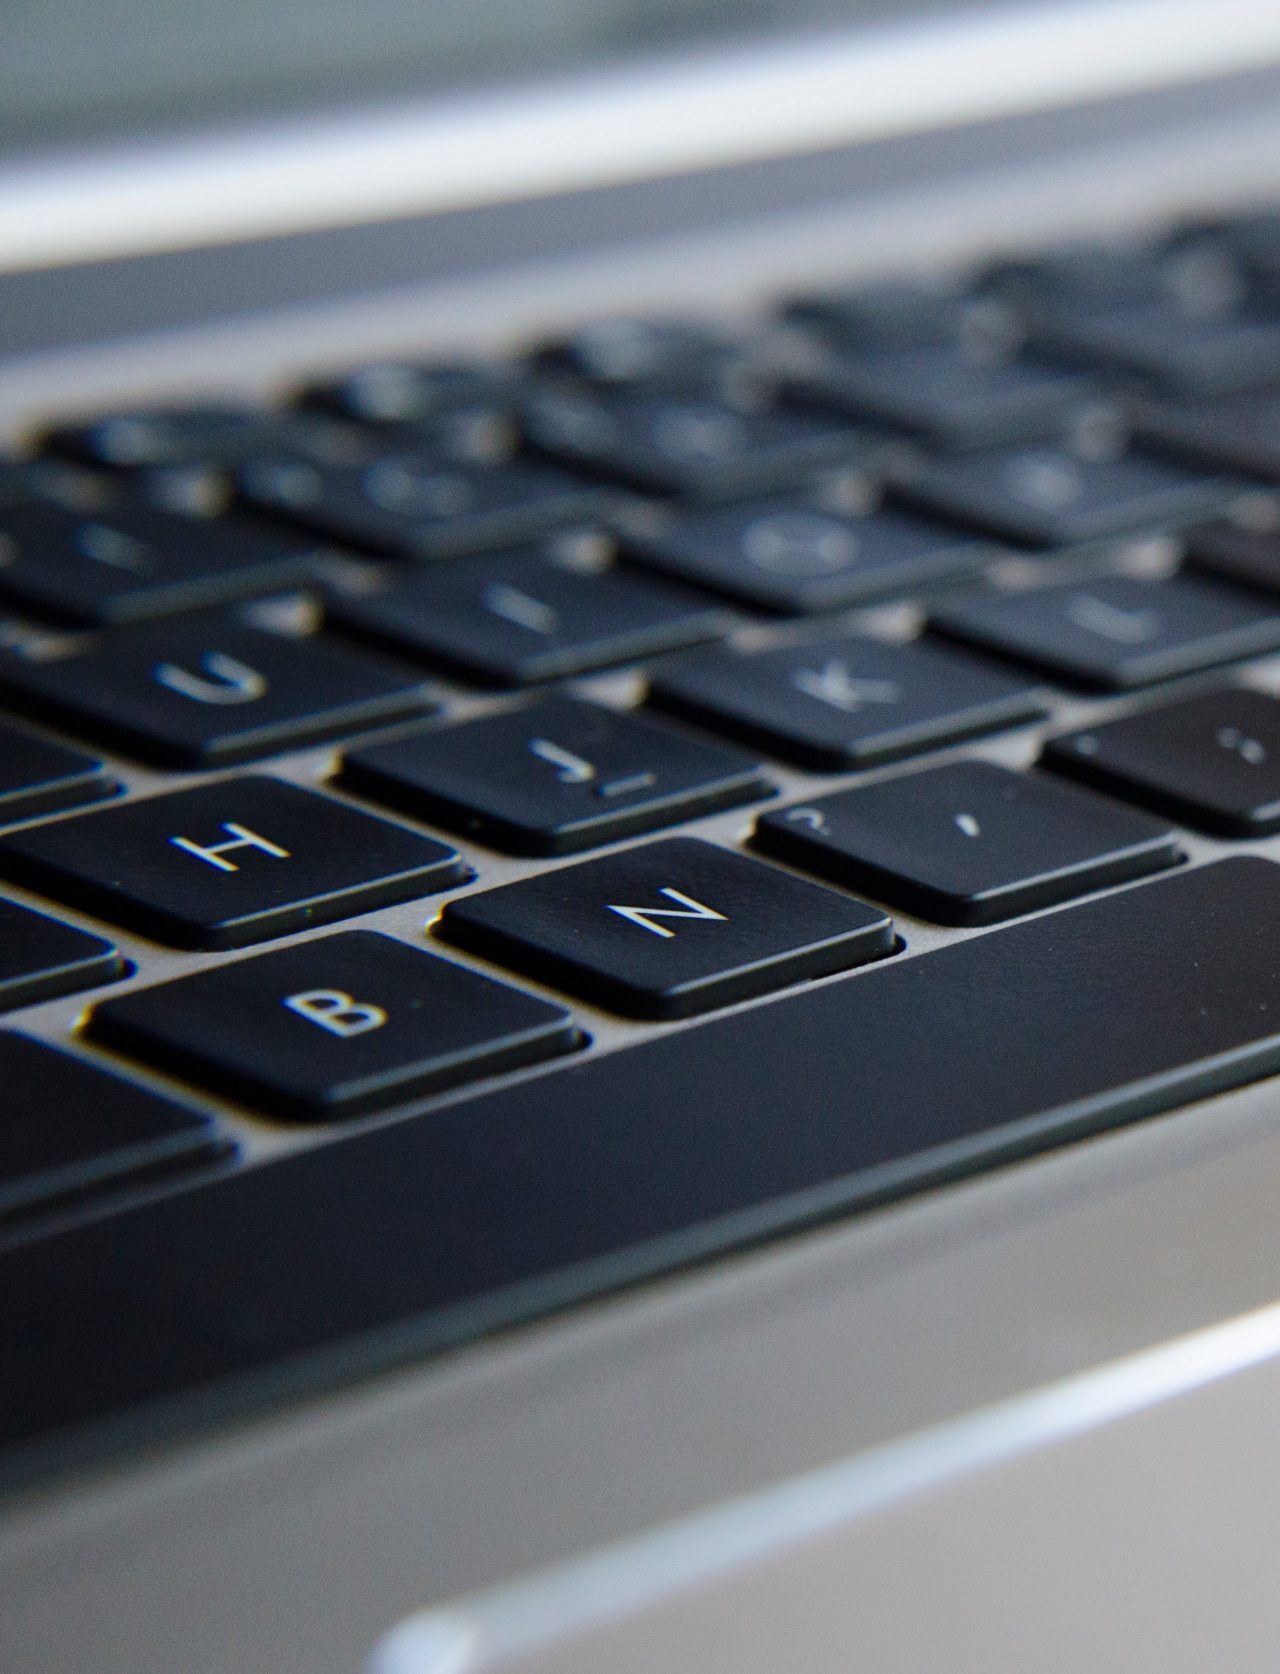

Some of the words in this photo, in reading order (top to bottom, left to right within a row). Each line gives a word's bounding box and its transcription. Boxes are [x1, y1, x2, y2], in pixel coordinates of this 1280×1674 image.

[152, 650, 268, 704] U
[793, 659, 903, 712] K
[528, 737, 597, 784] J
[166, 822, 291, 872] H
[604, 886, 732, 938] N
[281, 988, 389, 1038] B
